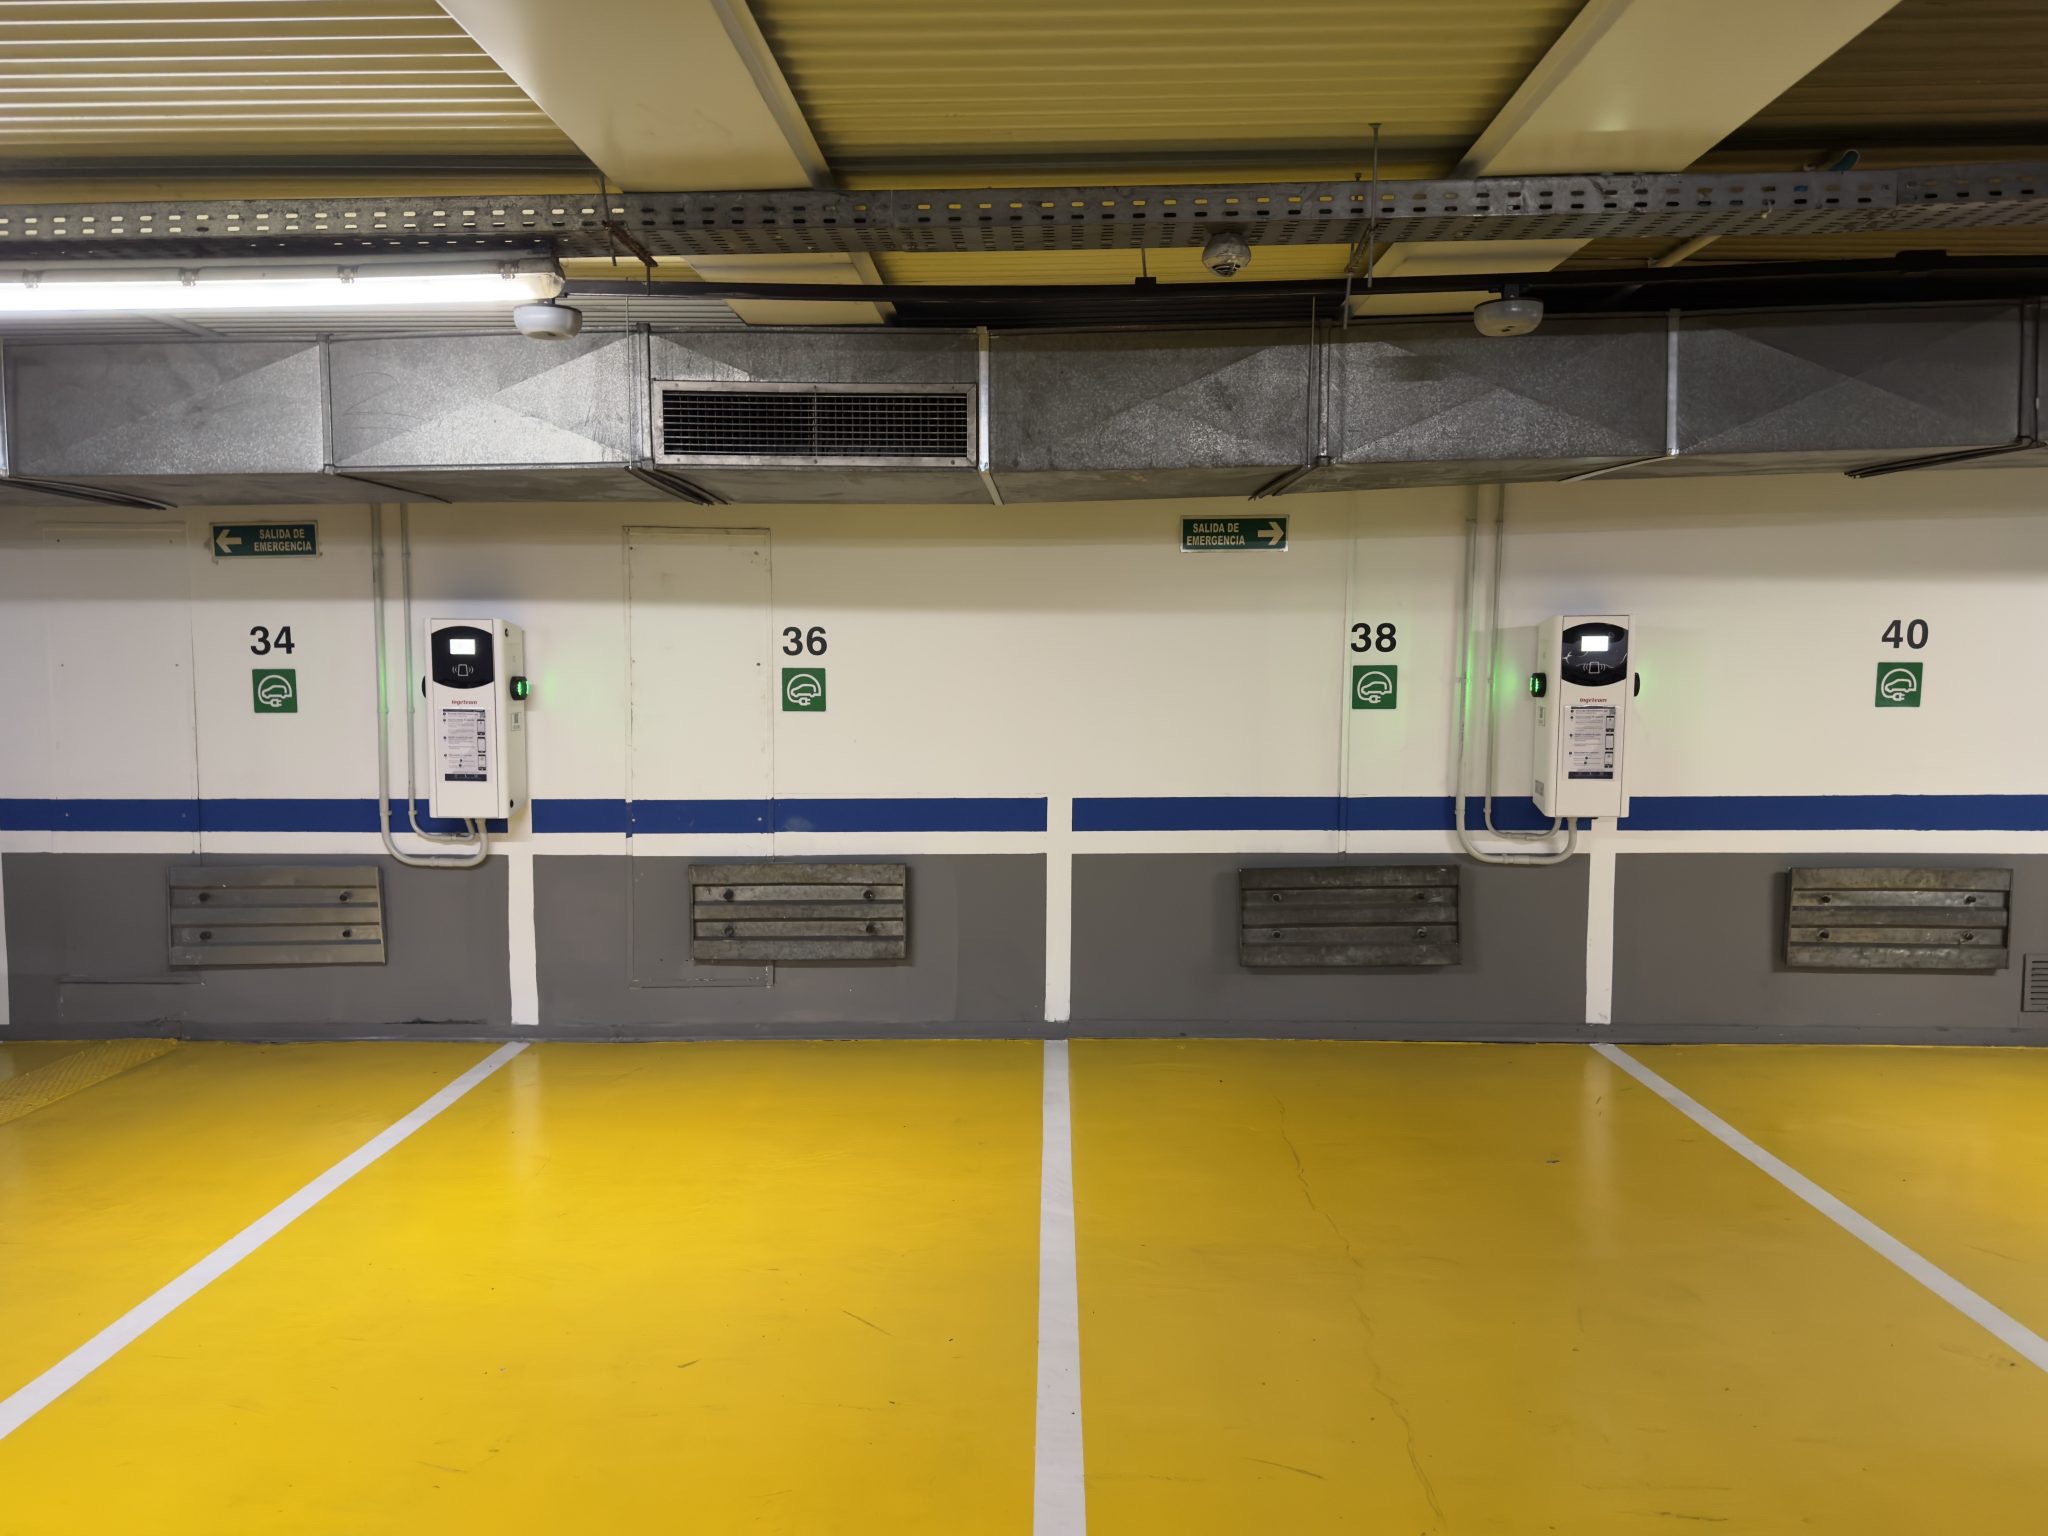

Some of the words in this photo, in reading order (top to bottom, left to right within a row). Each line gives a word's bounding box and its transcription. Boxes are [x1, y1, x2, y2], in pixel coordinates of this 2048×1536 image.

[259, 528, 291, 539] SALIDA
[293, 528, 305, 539] DE
[1193, 522, 1225, 533] SALIDA
[1227, 522, 1240, 533] DE
[253, 541, 313, 552] EMERGENCIA
[1186, 535, 1246, 546] EMERGENCIA
[250, 625, 295, 656] 34
[782, 626, 828, 656] 36
[1350, 622, 1397, 653] 38
[1881, 618, 1929, 650] 40
